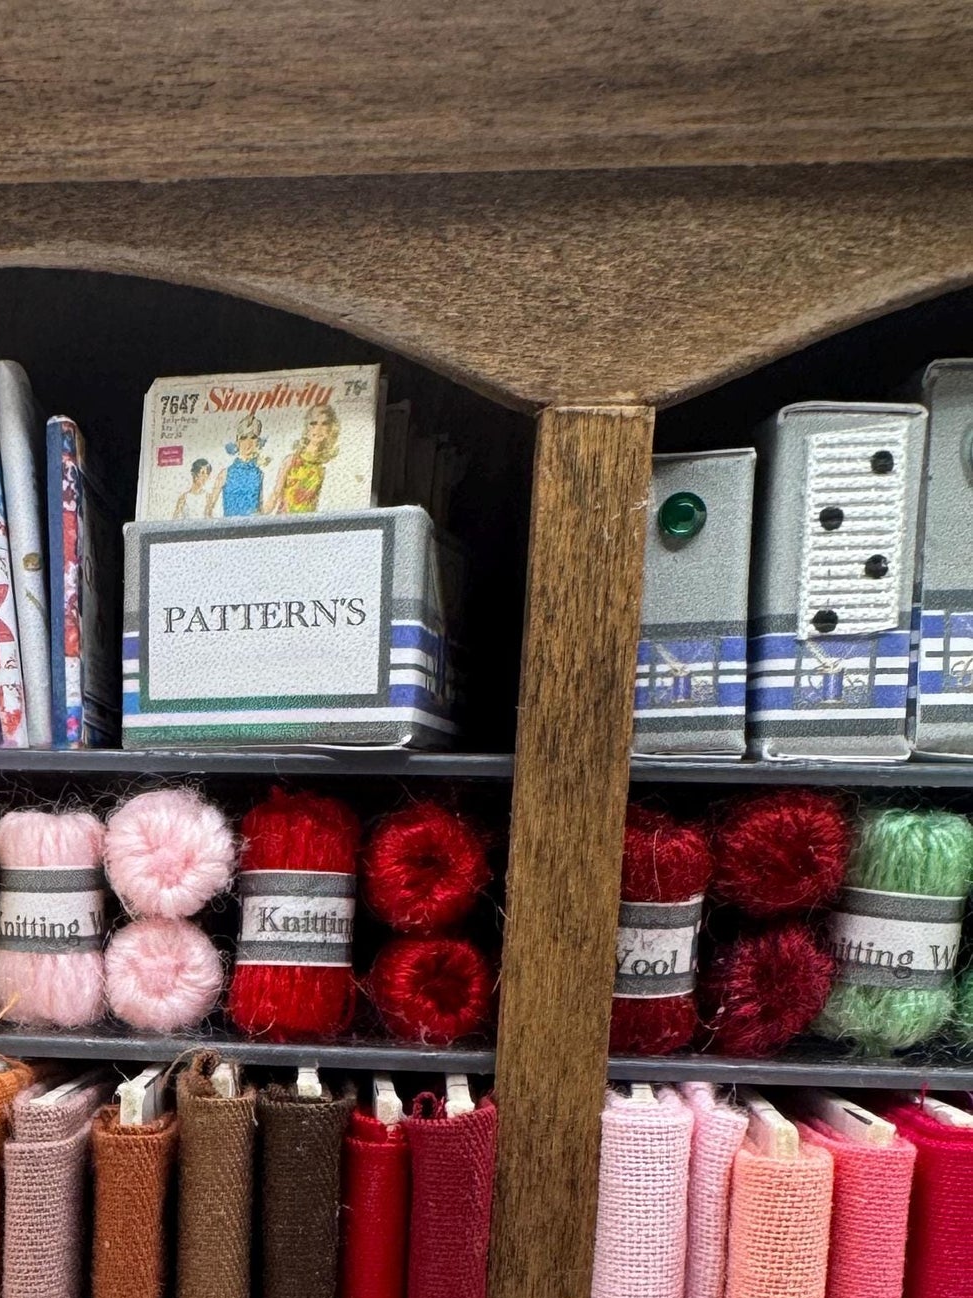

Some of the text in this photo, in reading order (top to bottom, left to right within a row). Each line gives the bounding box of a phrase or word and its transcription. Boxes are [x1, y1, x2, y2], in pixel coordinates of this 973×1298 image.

[160, 393, 200, 416] 7647
[208, 382, 334, 416] Simplicity
[163, 597, 367, 634] PATTERN'S
